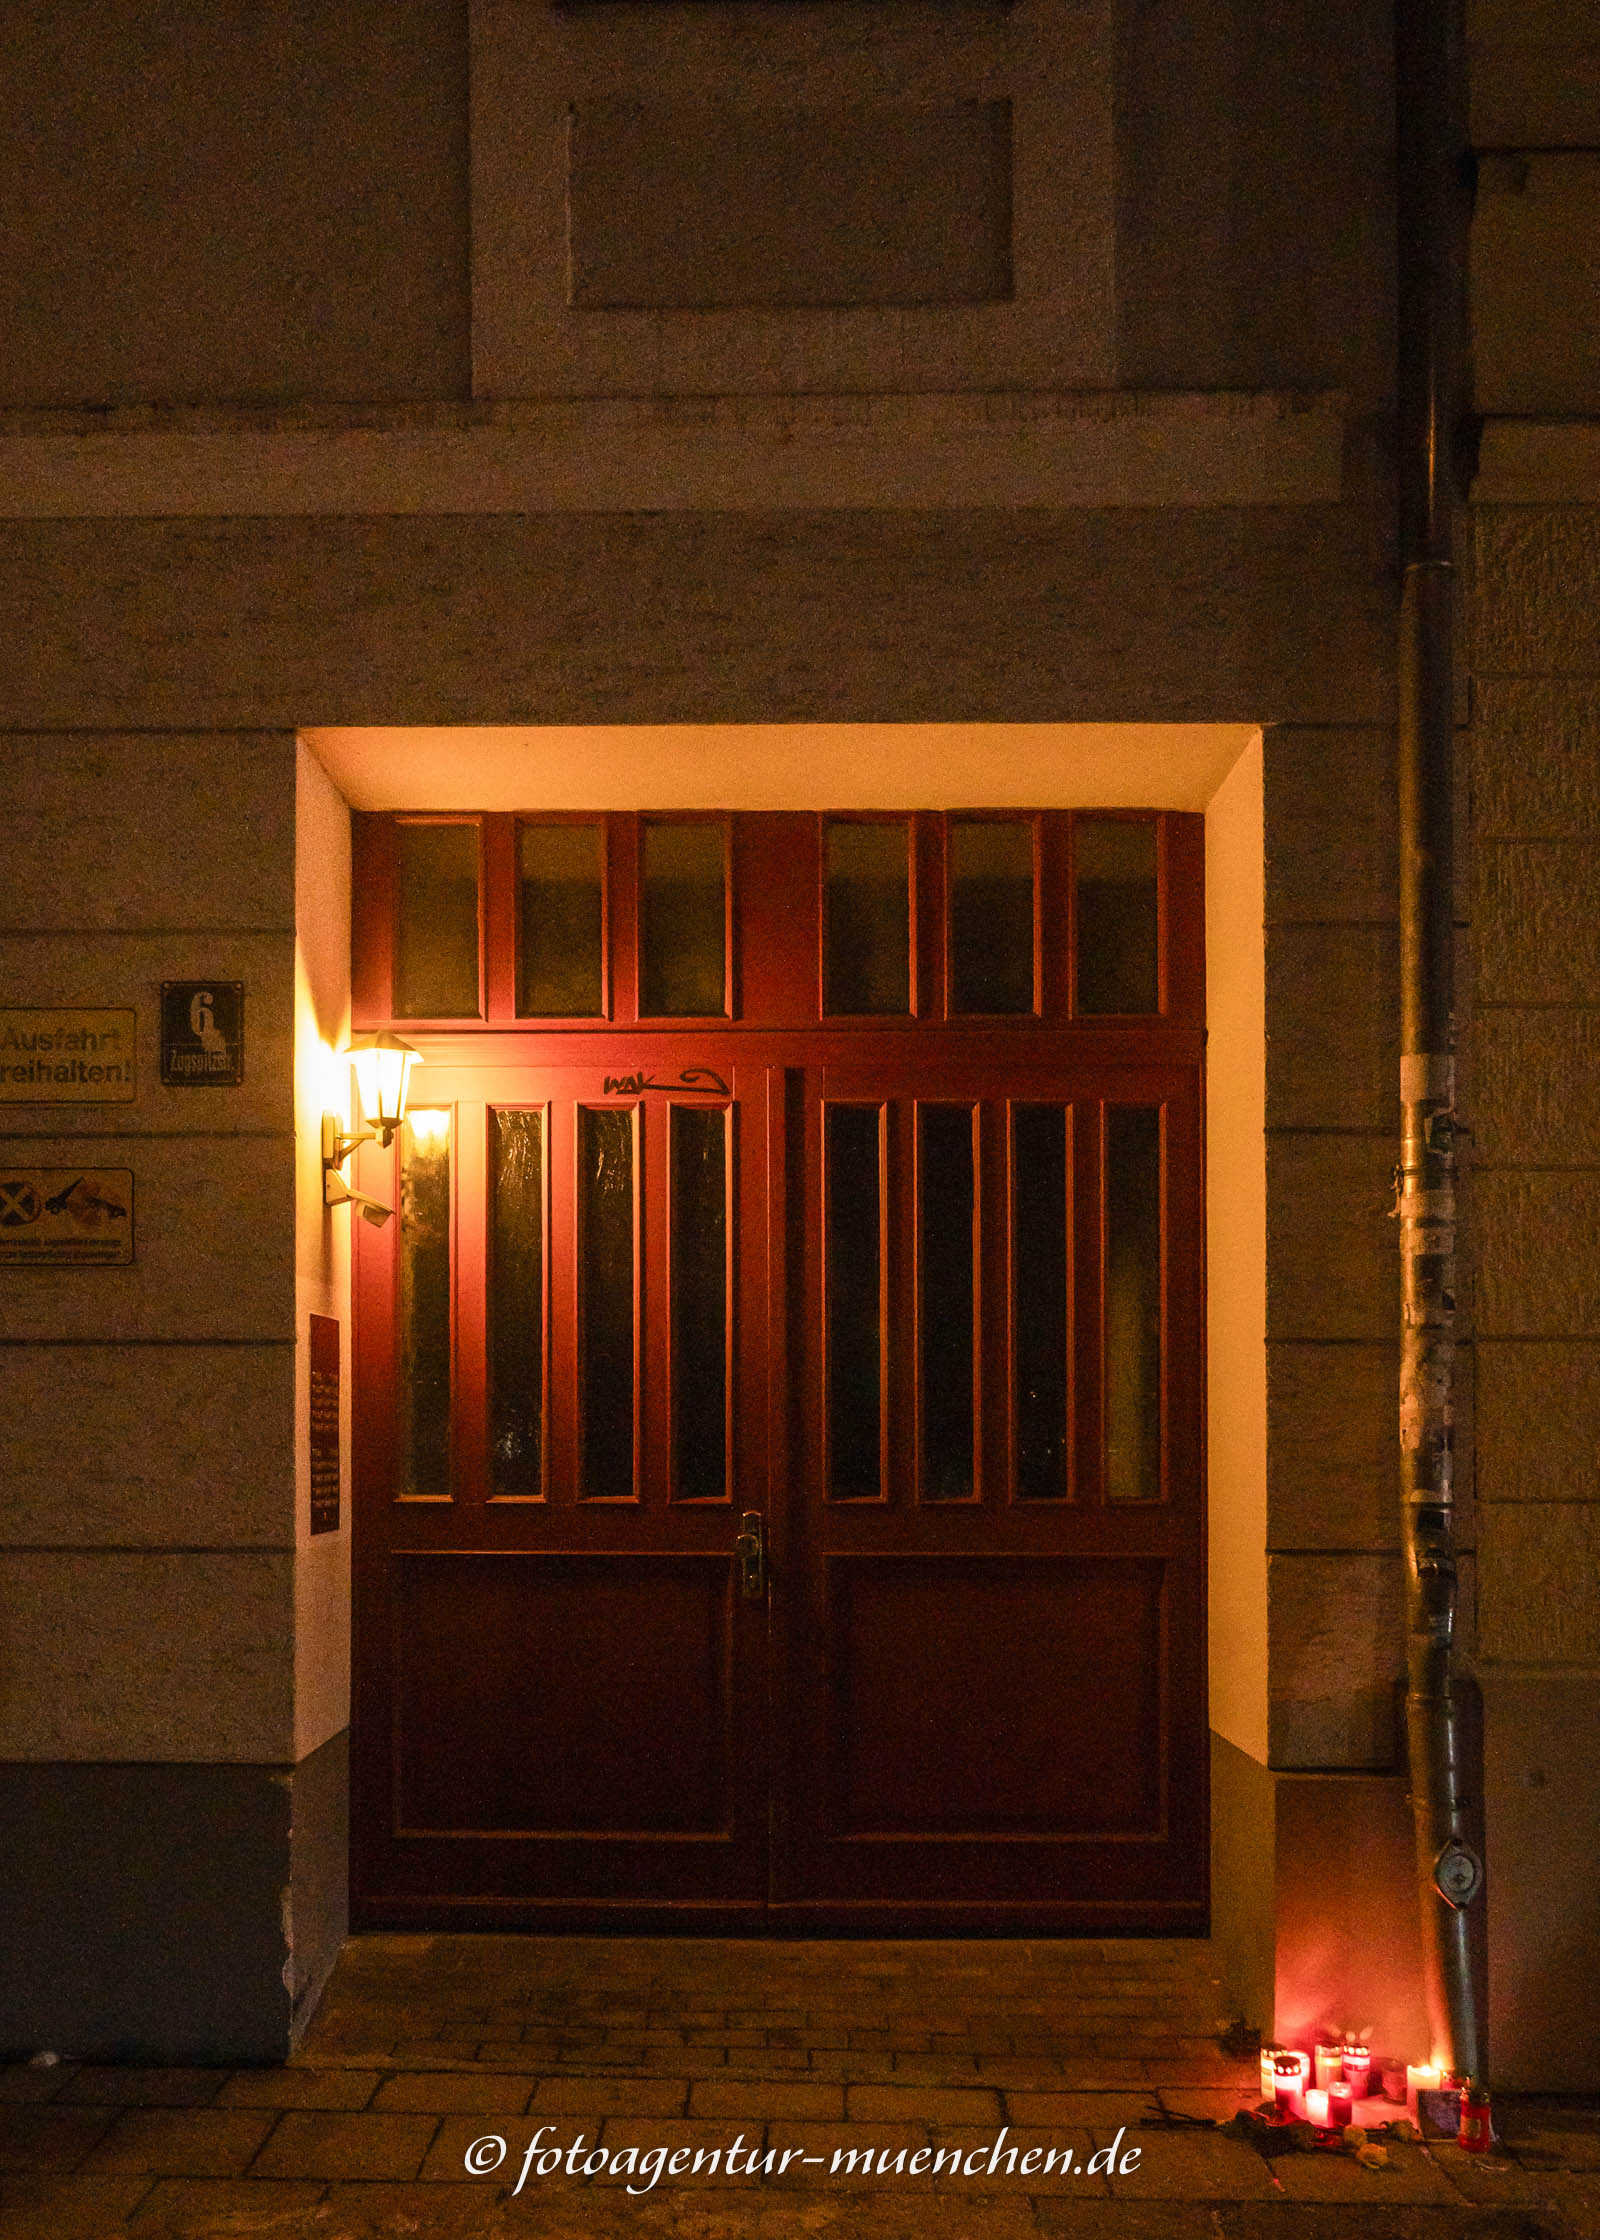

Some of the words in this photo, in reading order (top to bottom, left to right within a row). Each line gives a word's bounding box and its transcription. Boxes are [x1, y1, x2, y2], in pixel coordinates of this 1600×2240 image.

[190, 991, 214, 1035] 6
[0, 1028, 119, 1051] Ausfahrt
[0, 1059, 132, 1083] reihalten!
